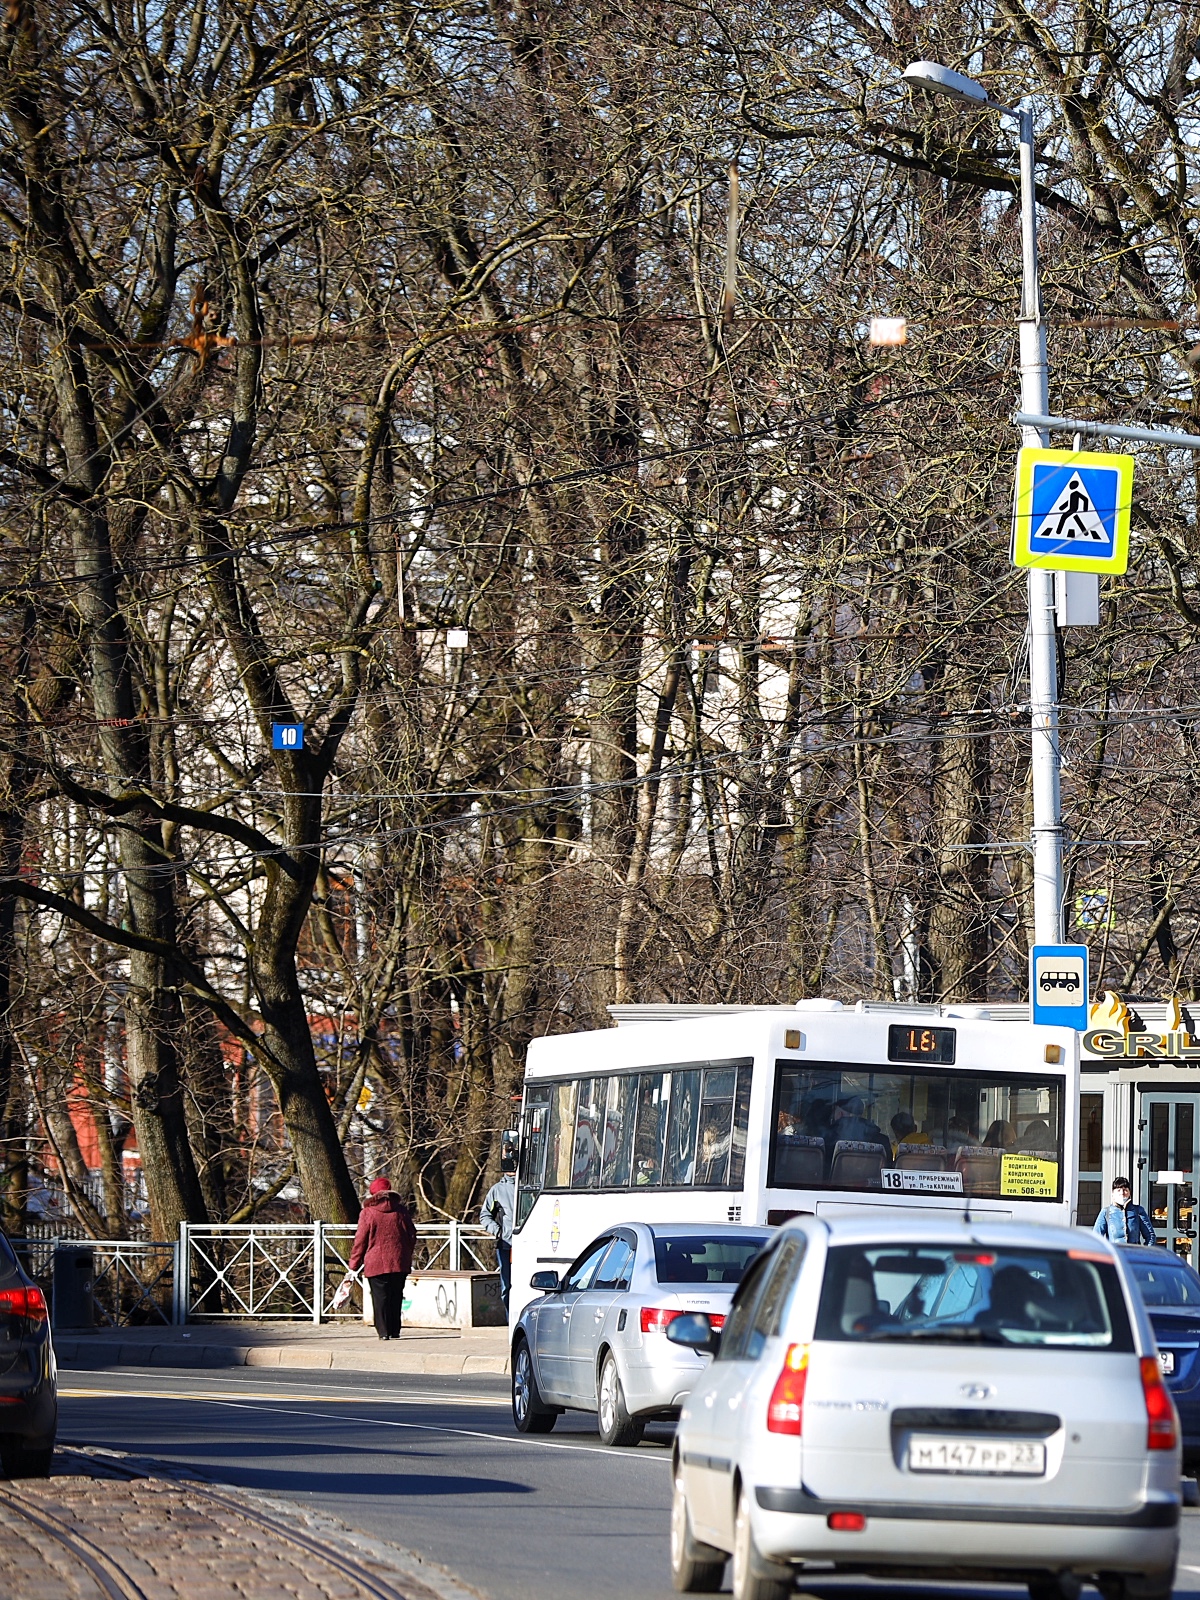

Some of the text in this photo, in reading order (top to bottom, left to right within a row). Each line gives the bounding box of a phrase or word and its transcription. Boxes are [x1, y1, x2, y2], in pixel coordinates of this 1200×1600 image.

[282, 728, 296, 745] 10
[885, 1172, 902, 1188] 18
[919, 1174, 960, 1183] ПРИБРЕЖНЫЙ
[1015, 1443, 1036, 1462] 23
